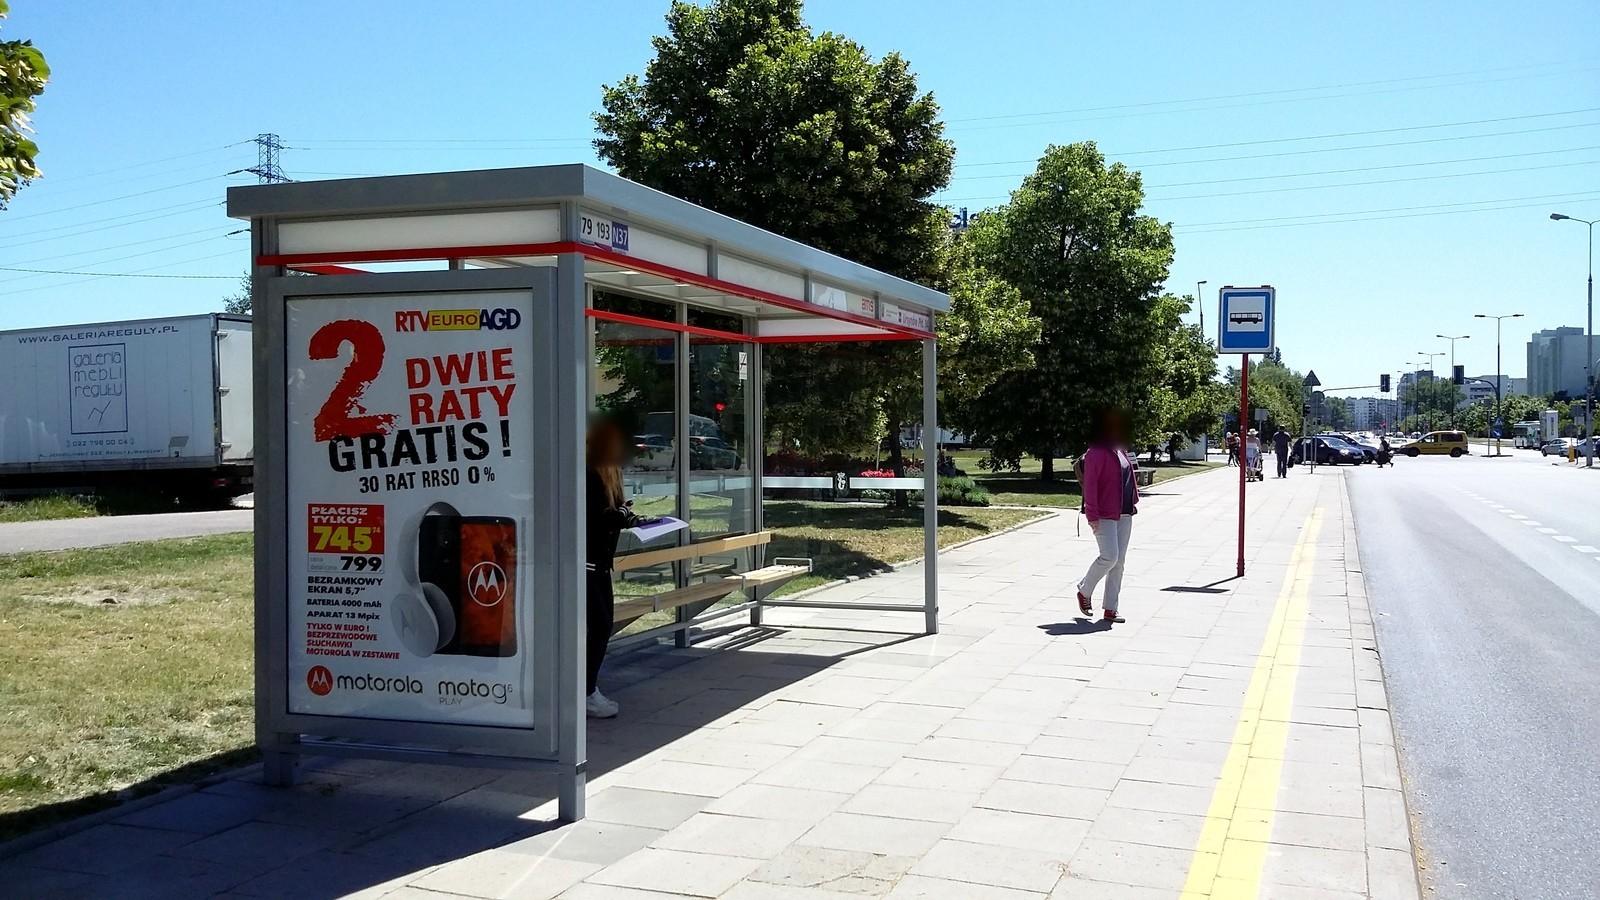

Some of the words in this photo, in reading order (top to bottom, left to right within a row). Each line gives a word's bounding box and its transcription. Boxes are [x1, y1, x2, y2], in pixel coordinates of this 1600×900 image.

[582, 217, 593, 235] 79
[597, 221, 610, 240] 193
[612, 227, 628, 246] N37
[395, 311, 430, 333] RTV
[431, 312, 478, 327] EURO
[480, 308, 521, 330] AGD
[18, 325, 179, 344] WWW.GALERIAREGULY.PL
[405, 348, 515, 390] DWIE
[308, 319, 400, 442] 2
[409, 384, 517, 425] RATY
[359, 476, 379, 493] 30
[386, 472, 416, 490] RAT
[422, 468, 460, 488] RRSO
[311, 507, 368, 516] PŁACISZ
[312, 516, 362, 524] TYLKO:
[313, 526, 373, 552] 745
[307, 576, 384, 586] BEZRAMKOWY
[307, 586, 343, 594] EKRAN
[307, 598, 340, 606] BATERIA
[341, 600, 362, 608] 4000
[363, 600, 382, 608] mAh
[358, 612, 380, 621] Mpix
[344, 624, 365, 632] EURO
[307, 631, 378, 641] BEZPRZEWODOWE
[306, 639, 353, 648] SŁUCHAWKI
[306, 648, 351, 657] MOTOROLA
[362, 651, 401, 660] ZESTAWIE
[337, 673, 423, 694] motorola
[439, 697, 463, 705] PLAY
